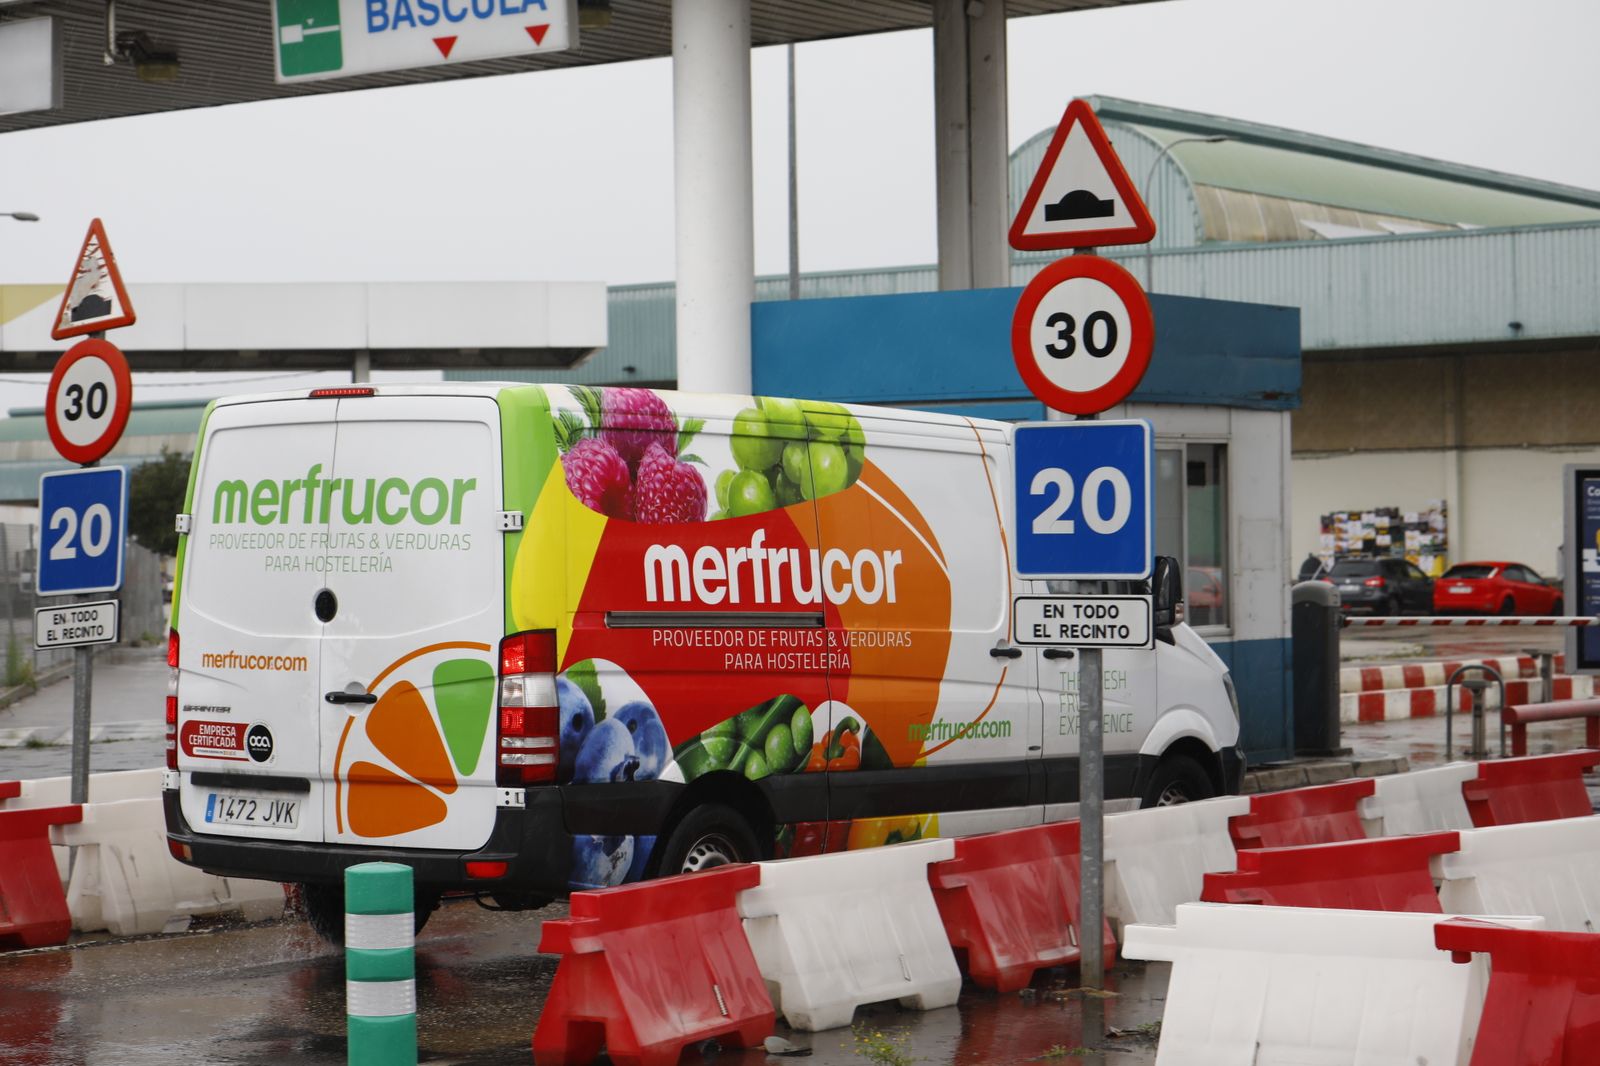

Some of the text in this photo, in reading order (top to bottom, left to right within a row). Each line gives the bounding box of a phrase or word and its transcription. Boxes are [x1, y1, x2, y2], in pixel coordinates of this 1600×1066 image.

[1045, 310, 1118, 359] 30
[64, 382, 108, 421] 30
[212, 463, 477, 525] merfrucor
[1029, 466, 1132, 534] 20
[49, 503, 112, 560] 20
[209, 532, 471, 550] PROVEEDOR DE FRUTAS & VERDURAS
[265, 552, 392, 572] PARA HOSTELERÍA
[644, 528, 902, 605] merfrucor
[53, 610, 98, 625] EN TODO
[1043, 604, 1119, 619] EN TODO
[47, 625, 104, 641] EL RECINTO
[653, 630, 912, 648] PROVEEDOR DE FRUTAS & VERDURAS
[1033, 624, 1130, 639] EL RECINTO
[202, 650, 307, 671] merfrucor.com
[725, 649, 850, 669] PARA HOSTELERÍA
[1103, 670, 1127, 690] ESH
[199, 725, 236, 737] EMPRESA
[908, 718, 1011, 741] merfrucor.com
[189, 734, 236, 748] CERTIFICADA
[219, 798, 257, 820] 1472
[263, 800, 295, 823] JVK
